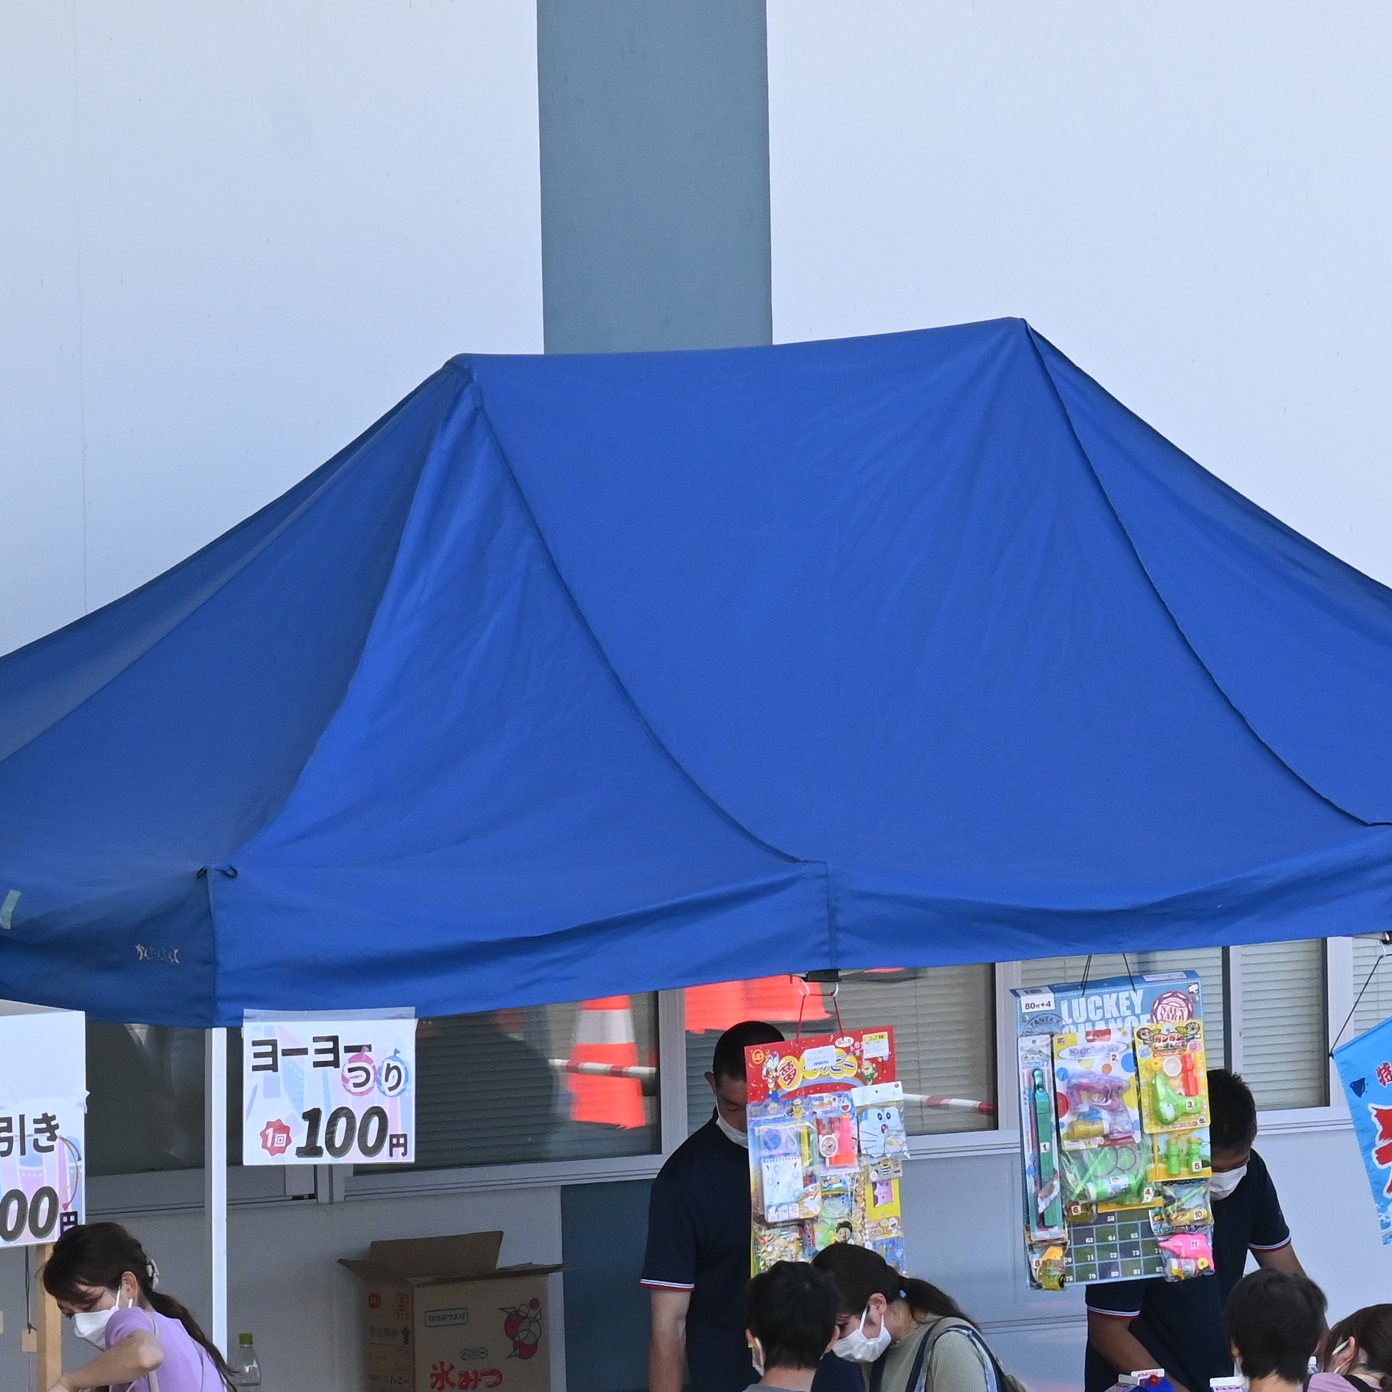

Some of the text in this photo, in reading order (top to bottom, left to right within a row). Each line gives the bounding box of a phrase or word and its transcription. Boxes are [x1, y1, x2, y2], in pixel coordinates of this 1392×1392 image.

[1060, 989, 1145, 1025] LUCKEY
[265, 1105, 408, 1159] 1回 100円
[429, 1360, 504, 1392] 氷みつ
